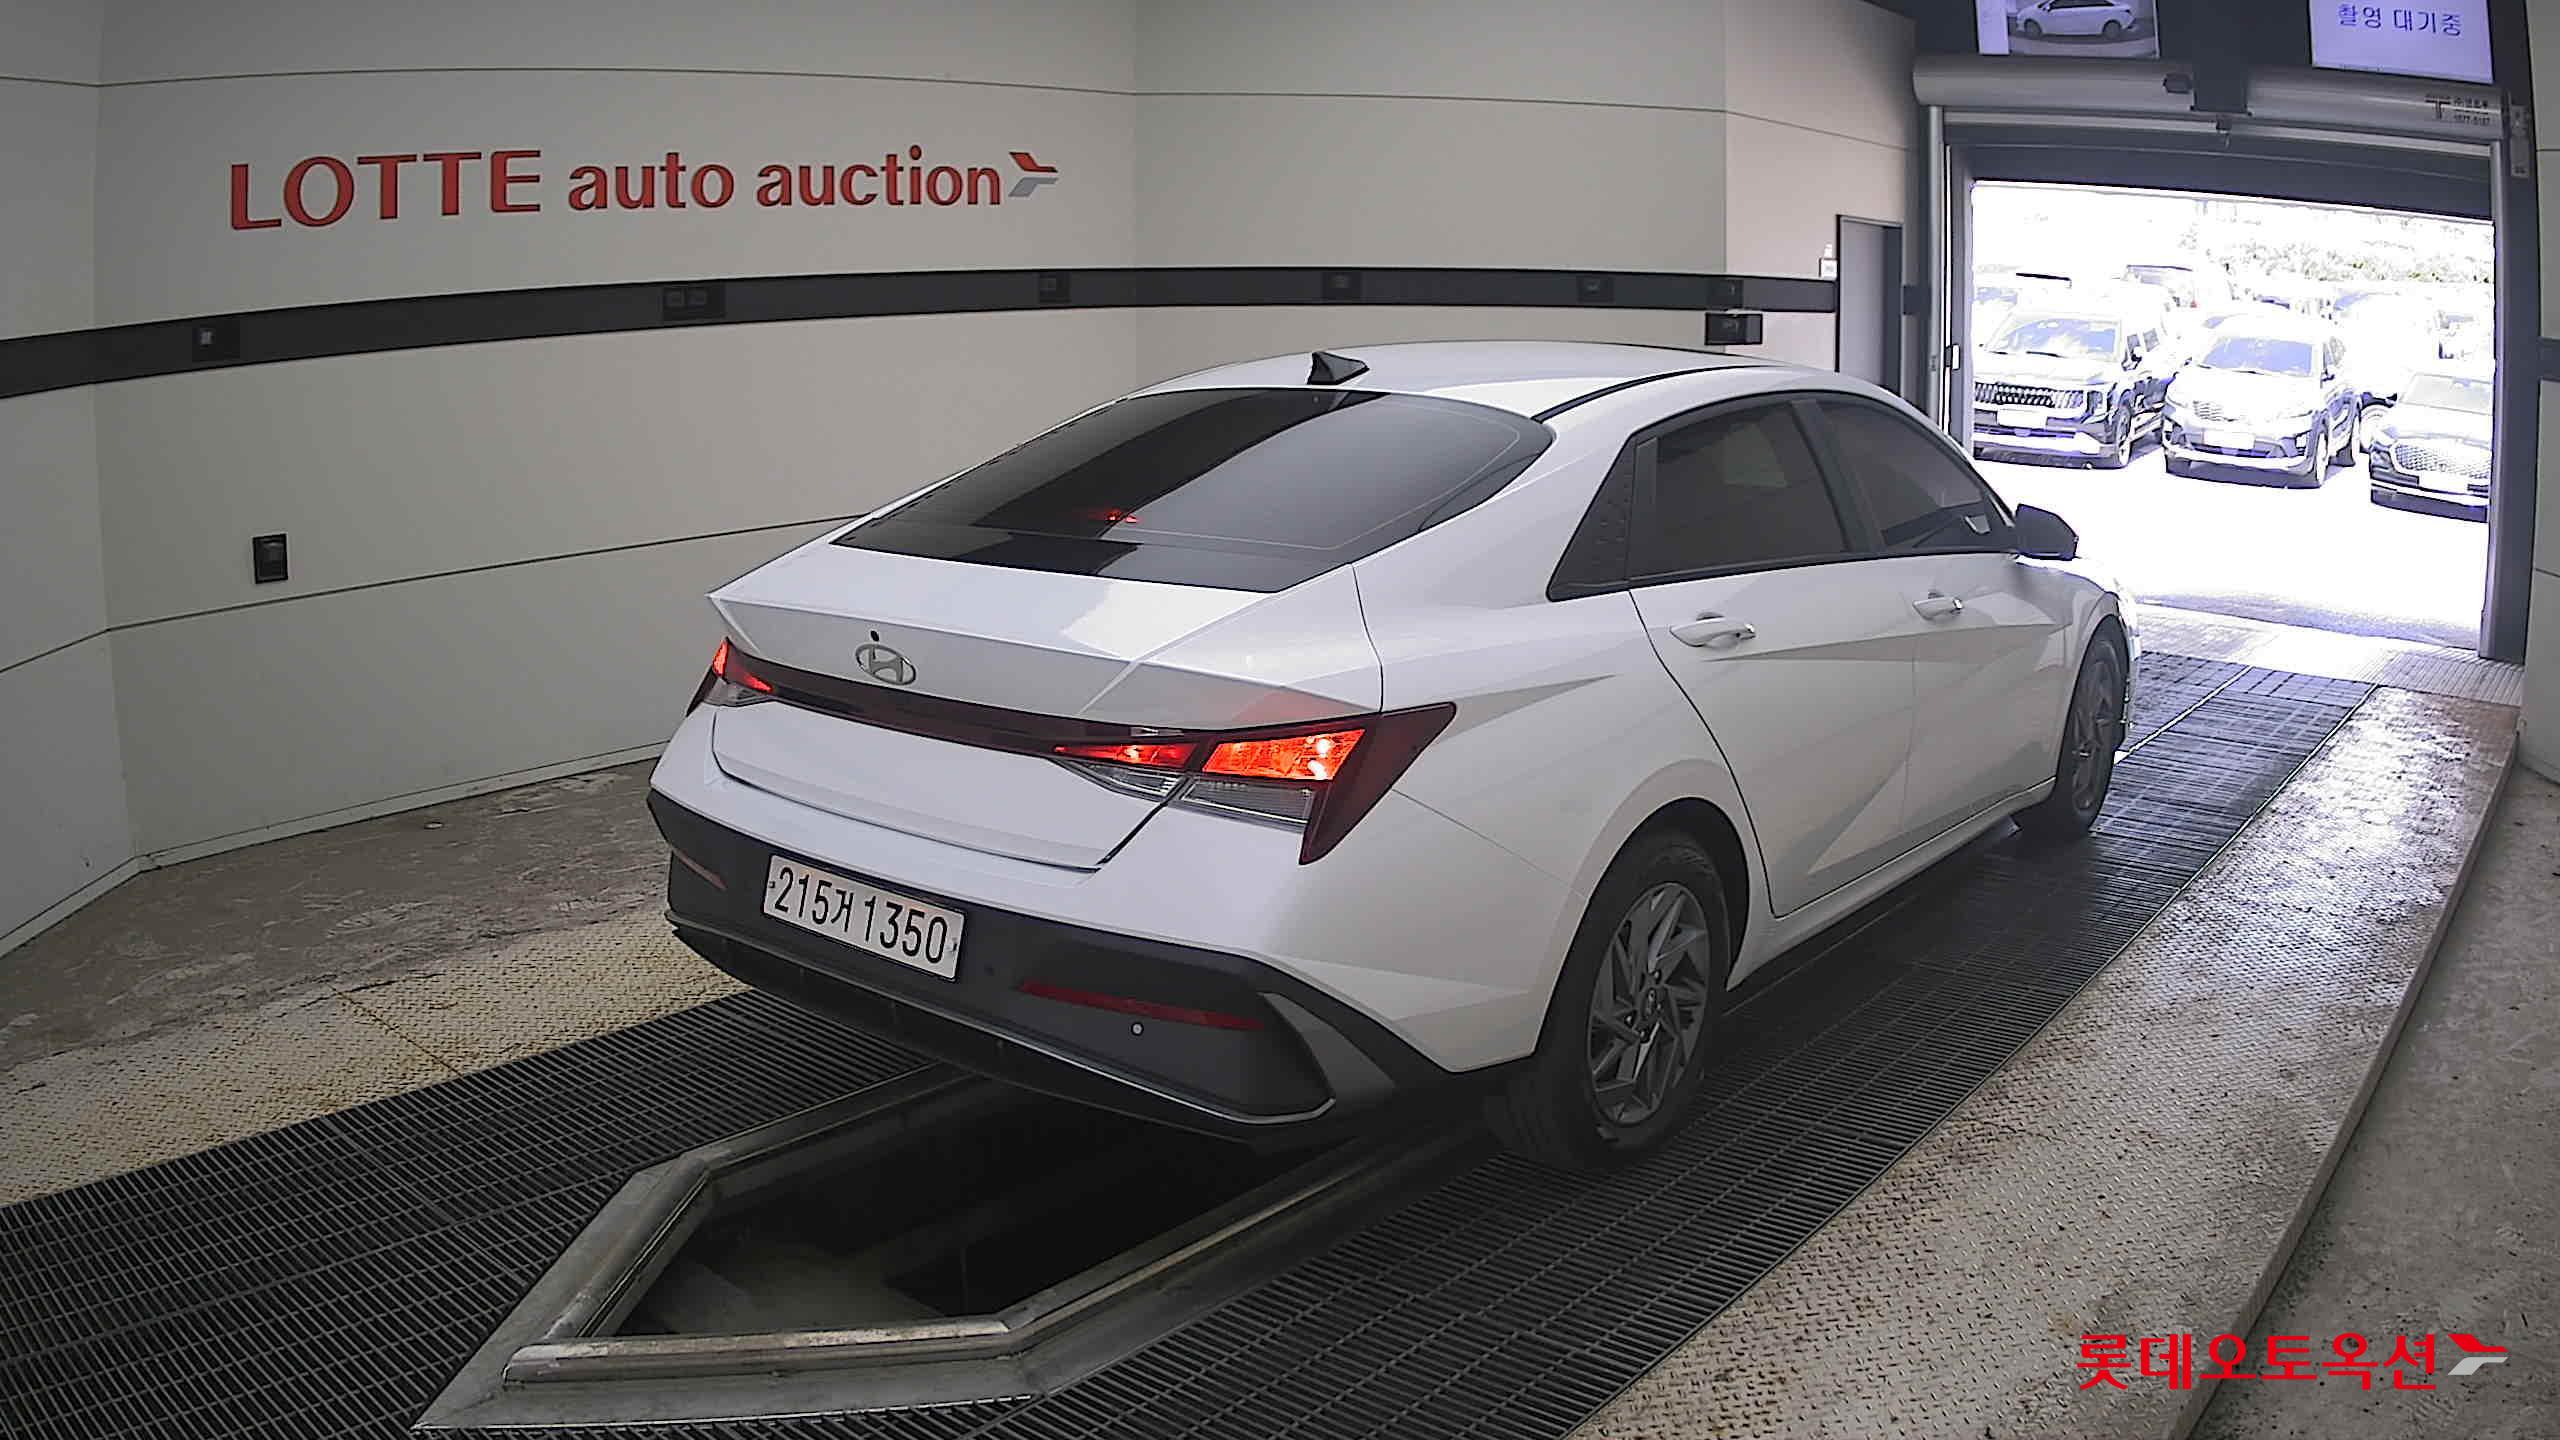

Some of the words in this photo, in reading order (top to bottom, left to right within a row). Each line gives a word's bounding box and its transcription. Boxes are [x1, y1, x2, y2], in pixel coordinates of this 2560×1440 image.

[2393, 9, 2463, 37] 대기중
[231, 150, 541, 230] LOTTE
[568, 152, 735, 209] auto
[756, 145, 1001, 206] auction
